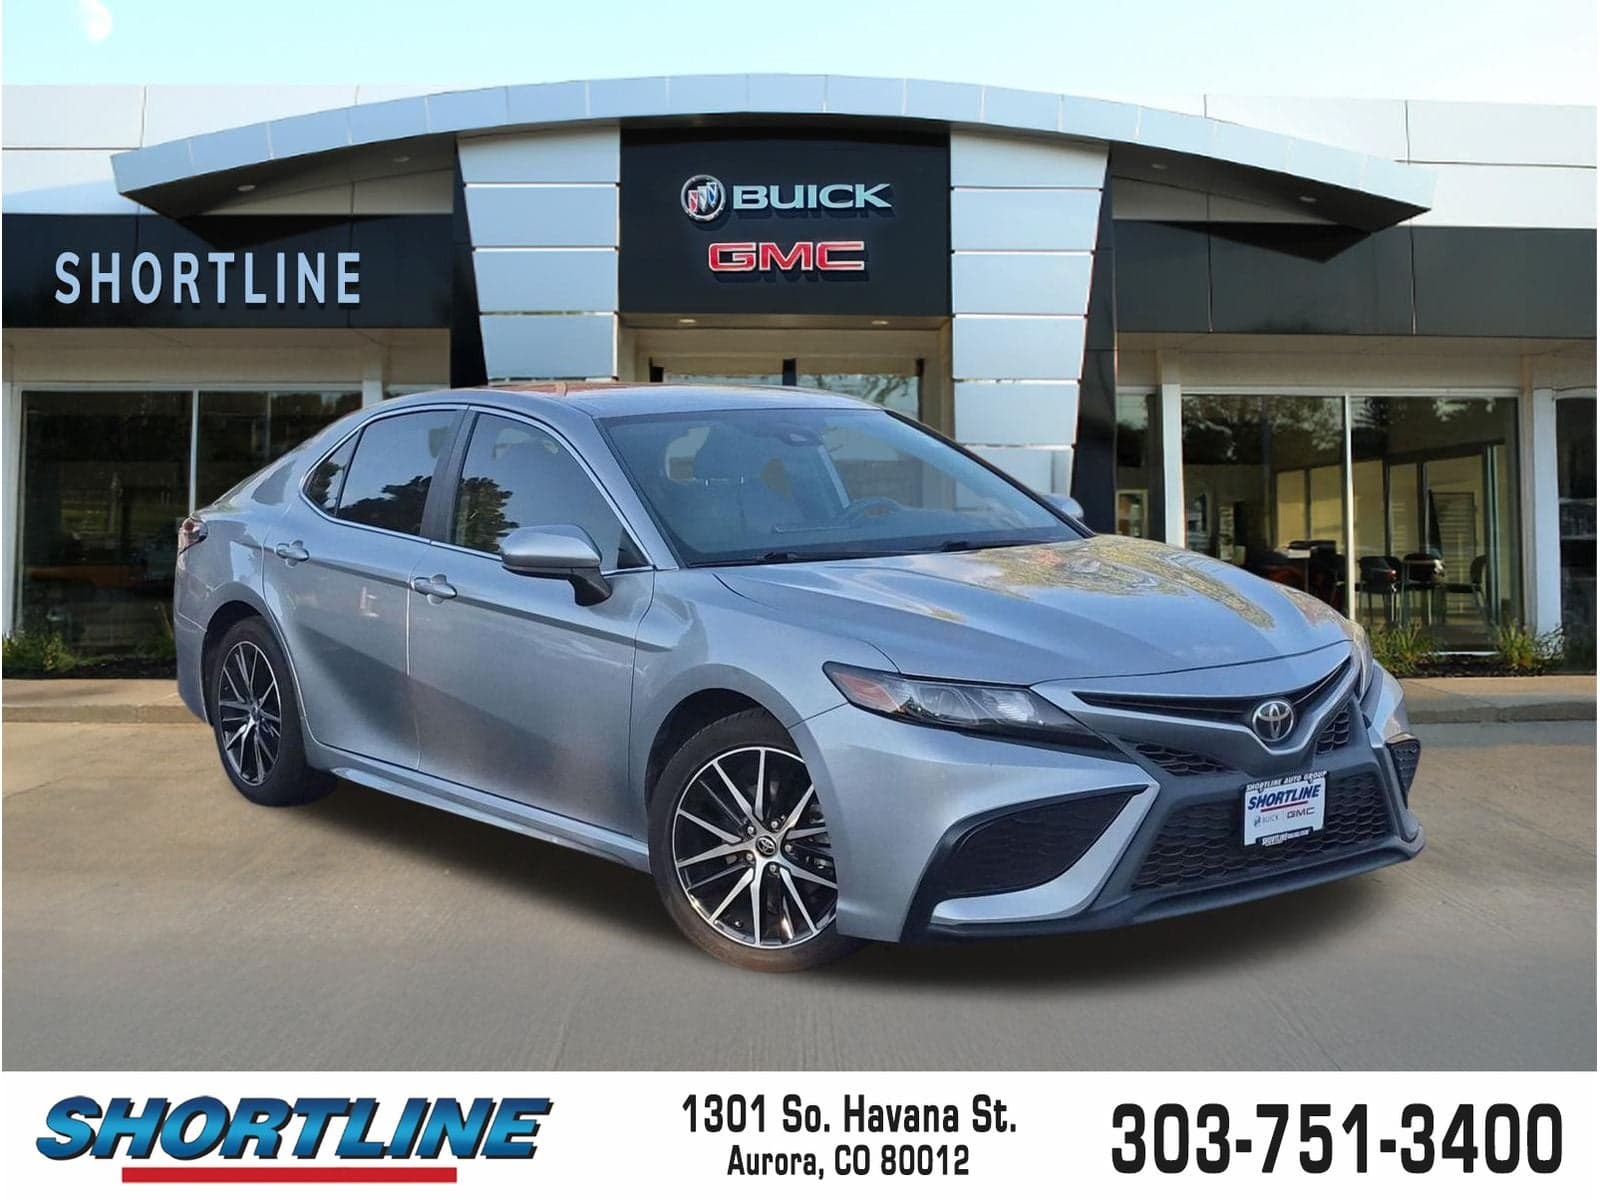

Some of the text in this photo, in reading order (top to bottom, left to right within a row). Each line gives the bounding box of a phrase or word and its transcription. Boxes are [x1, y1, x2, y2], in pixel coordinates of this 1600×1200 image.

[733, 183, 892, 210] BUICK
[708, 241, 865, 272] GMC
[55, 252, 360, 303] SHORTLINE
[1248, 784, 1321, 810] SHORTLINE
[1287, 807, 1315, 819] GMC
